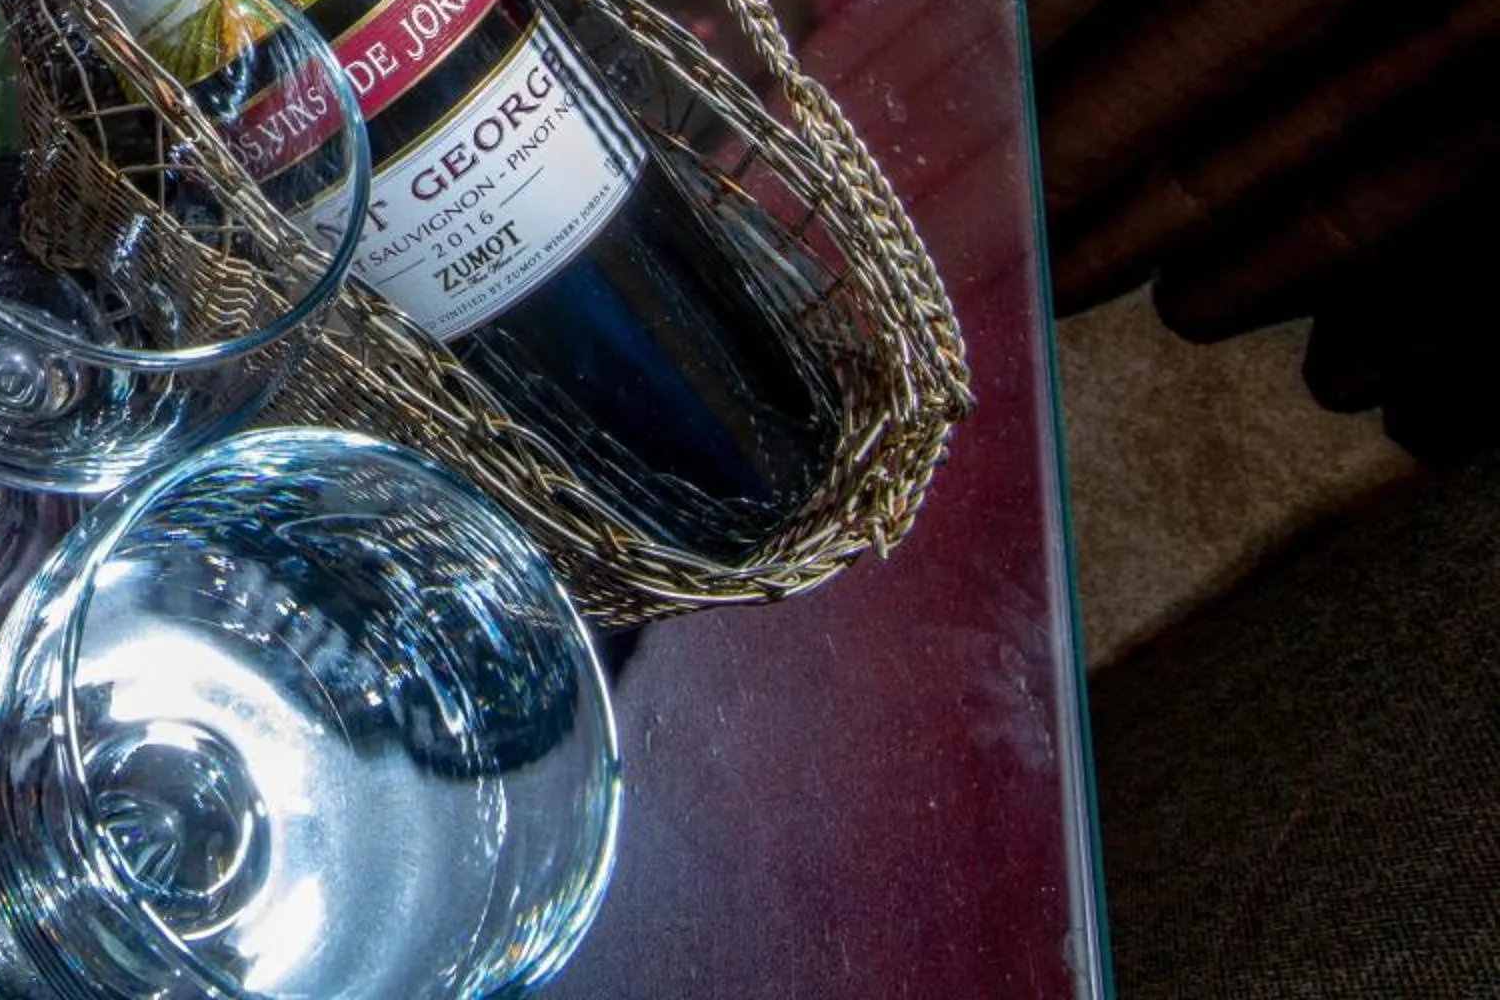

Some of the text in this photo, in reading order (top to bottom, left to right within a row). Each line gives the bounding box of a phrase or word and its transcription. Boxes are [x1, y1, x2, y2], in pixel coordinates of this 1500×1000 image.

[257, 87, 328, 146] VINS
[345, 41, 399, 95] DE
[411, 47, 565, 201] GEORGE
[370, 175, 496, 266] SAUVIGNON
[507, 115, 556, 171] PINOT
[431, 211, 494, 259] 2016
[433, 220, 522, 292] ZUMOT
[489, 283, 502, 296] BY
[503, 252, 543, 284] ZUMOT
[545, 216, 581, 252] WINERY
